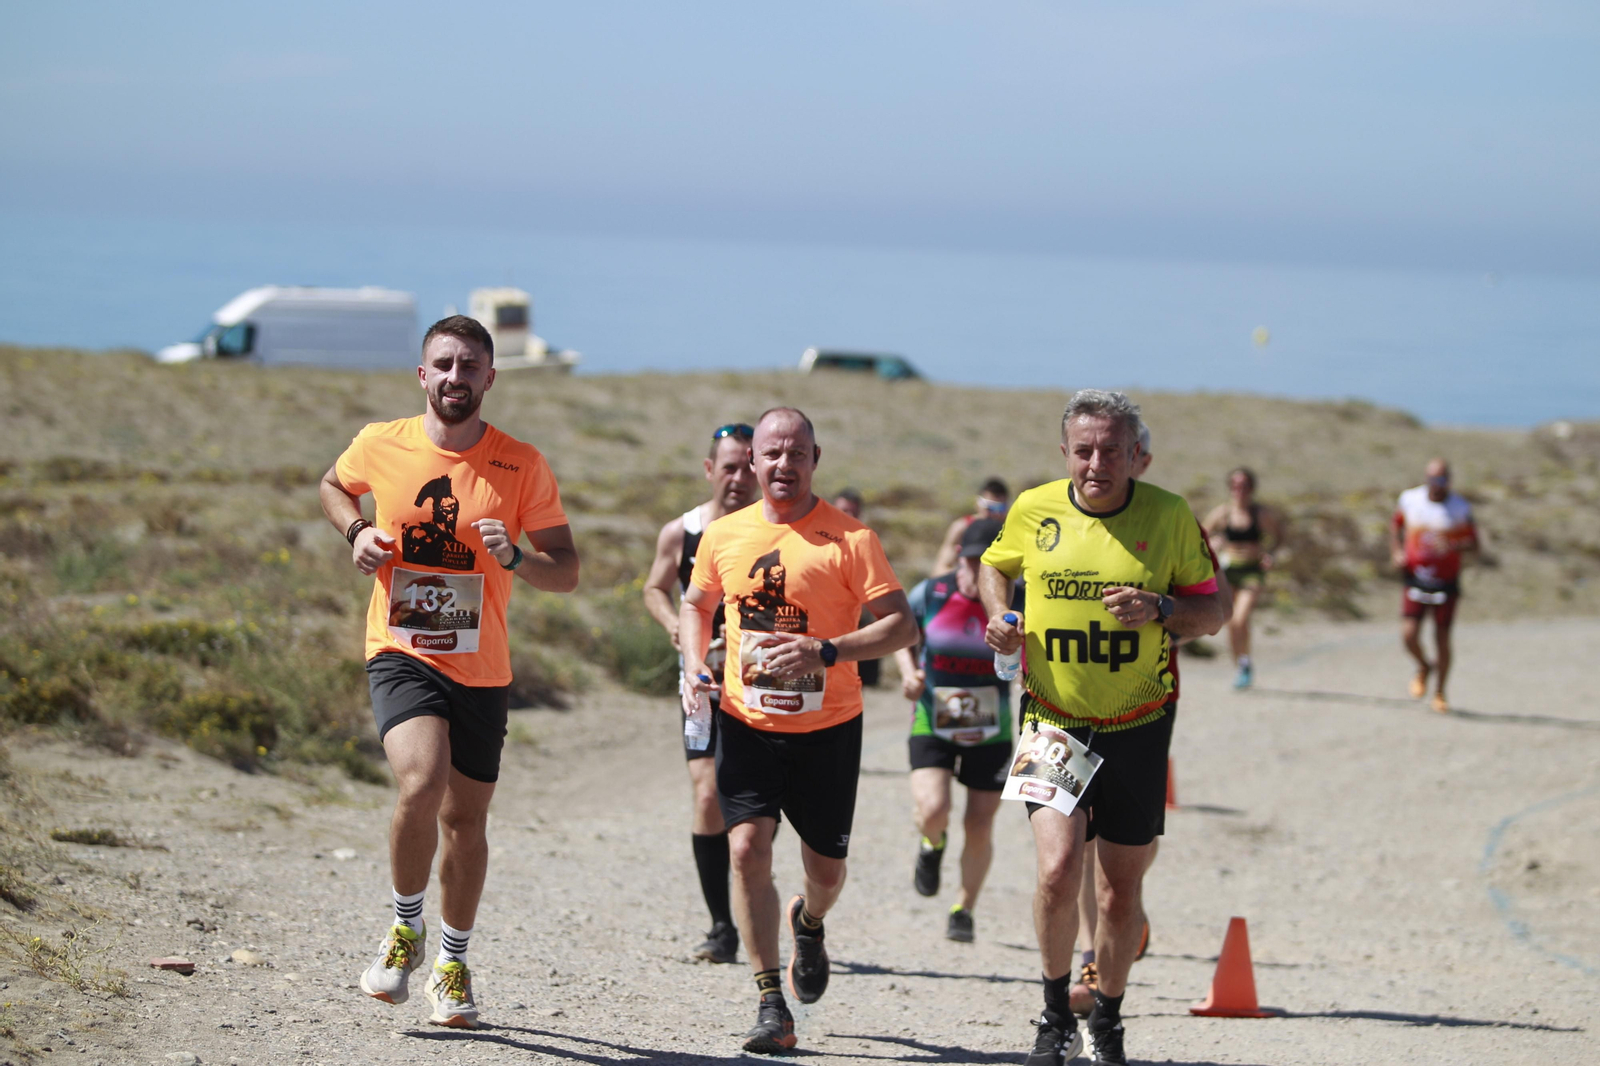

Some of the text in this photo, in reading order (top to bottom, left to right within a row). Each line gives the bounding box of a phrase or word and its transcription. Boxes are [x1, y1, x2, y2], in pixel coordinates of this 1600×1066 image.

[443, 540, 468, 553] XIII
[1041, 568, 1099, 580] Centro Deportivo
[405, 583, 457, 612] 132
[775, 605, 800, 616] XIII
[1045, 620, 1140, 672] mtp
[1029, 736, 1066, 764] 30
